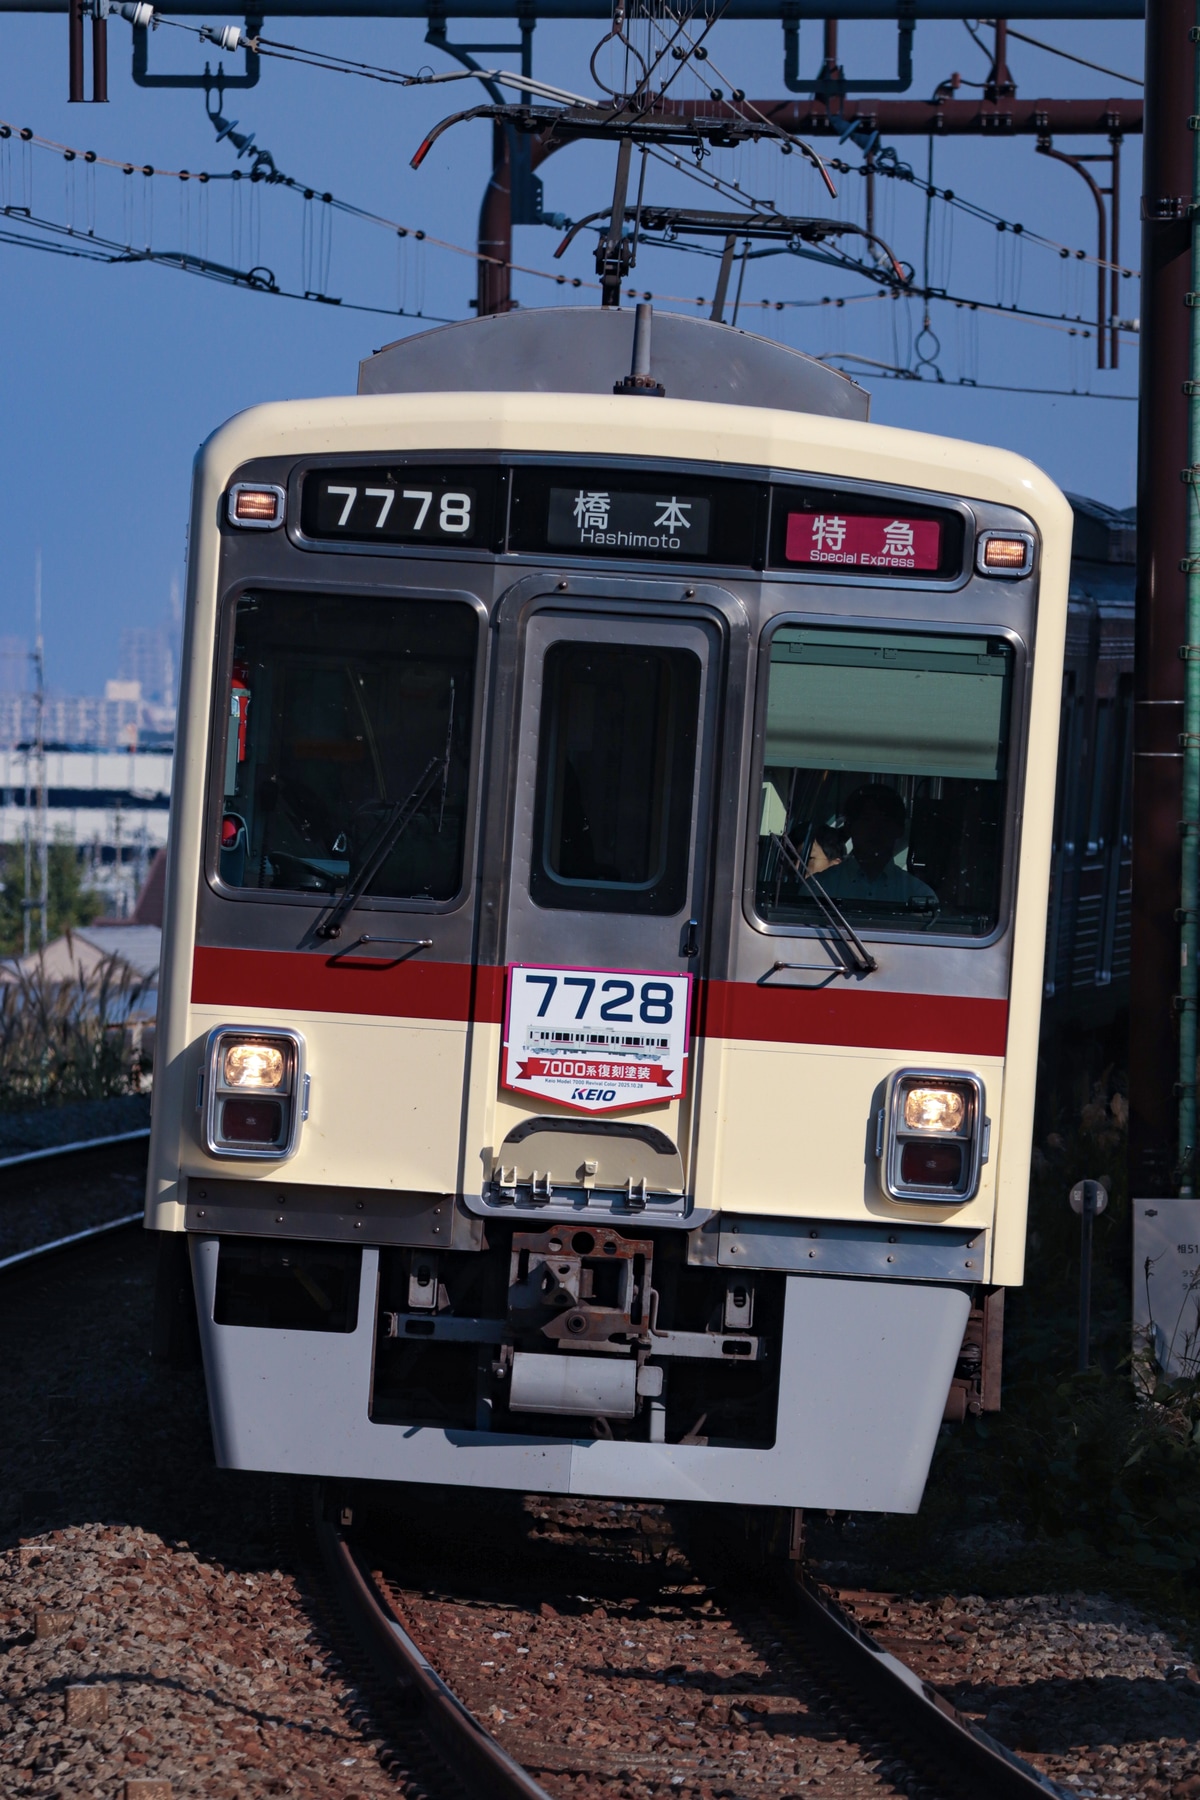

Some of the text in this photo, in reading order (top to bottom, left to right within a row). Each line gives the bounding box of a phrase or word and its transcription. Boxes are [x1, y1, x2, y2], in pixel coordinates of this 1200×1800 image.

[328, 486, 471, 532] 7778
[573, 490, 692, 534] 橋本
[580, 528, 681, 549] Hashimoto
[812, 515, 915, 556] 特急
[810, 550, 915, 568] Special Express
[526, 975, 674, 1024] 7728
[539, 1060, 651, 1080] 7000系復刻塗装
[571, 1088, 617, 1102] KEIO
